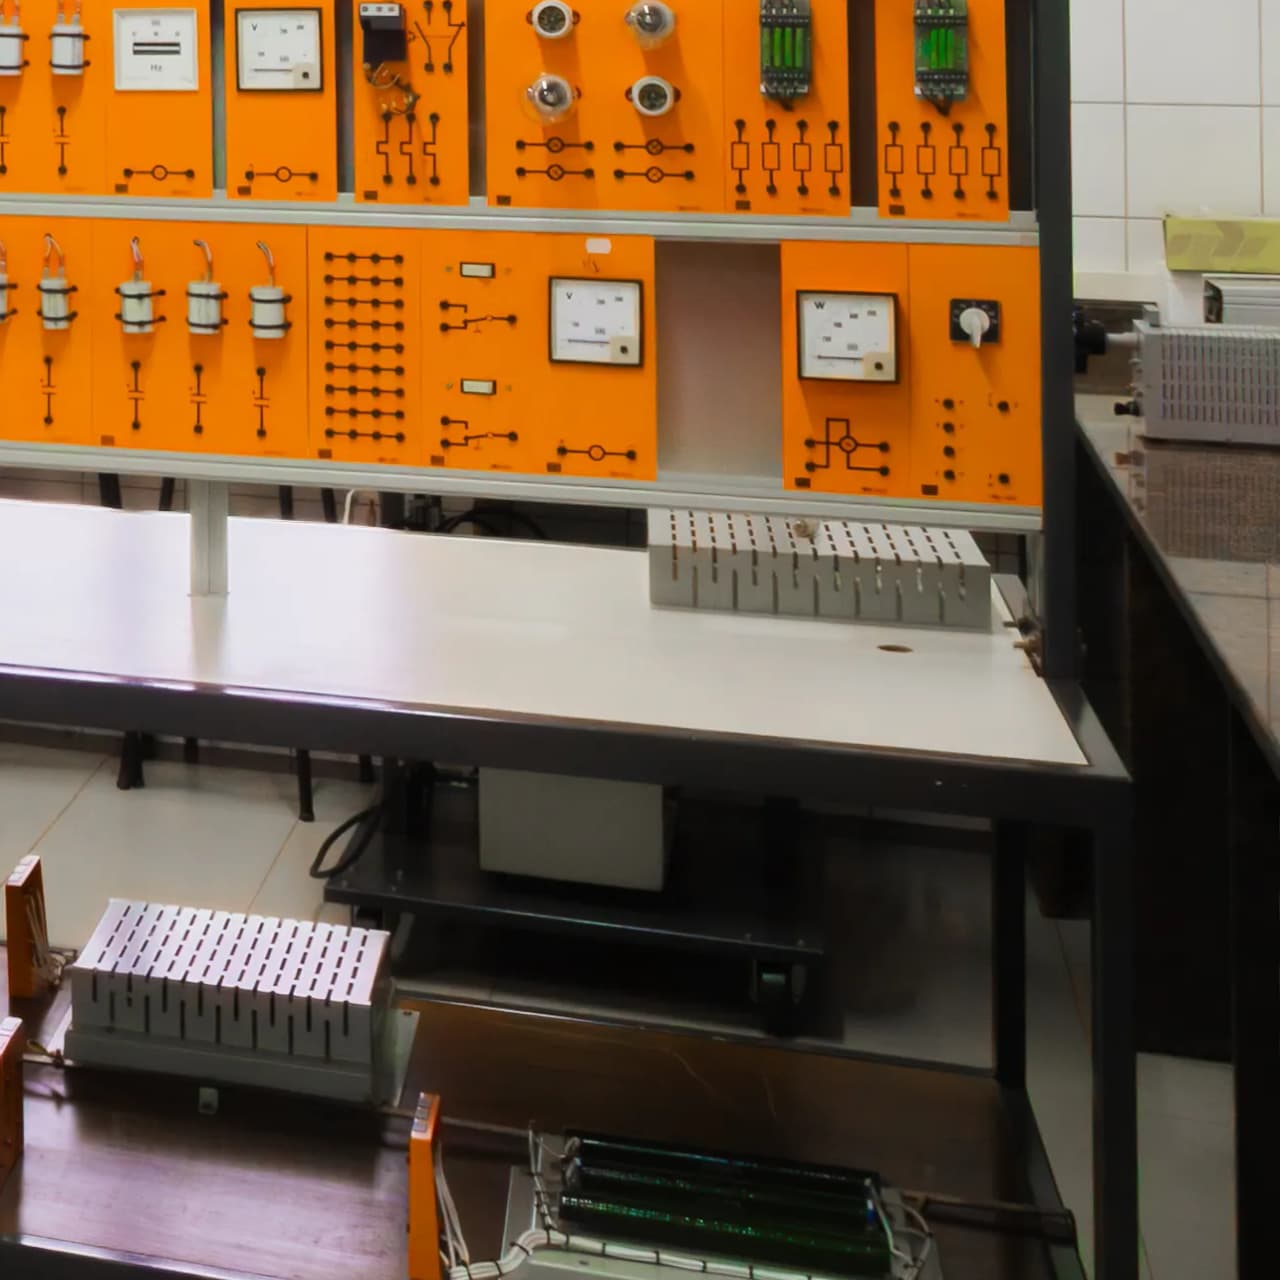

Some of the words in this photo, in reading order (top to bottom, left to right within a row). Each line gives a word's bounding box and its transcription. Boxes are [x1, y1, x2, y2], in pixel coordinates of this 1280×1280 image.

[251, 23, 258, 31] V
[566, 292, 573, 300] V
[814, 301, 825, 310] W
